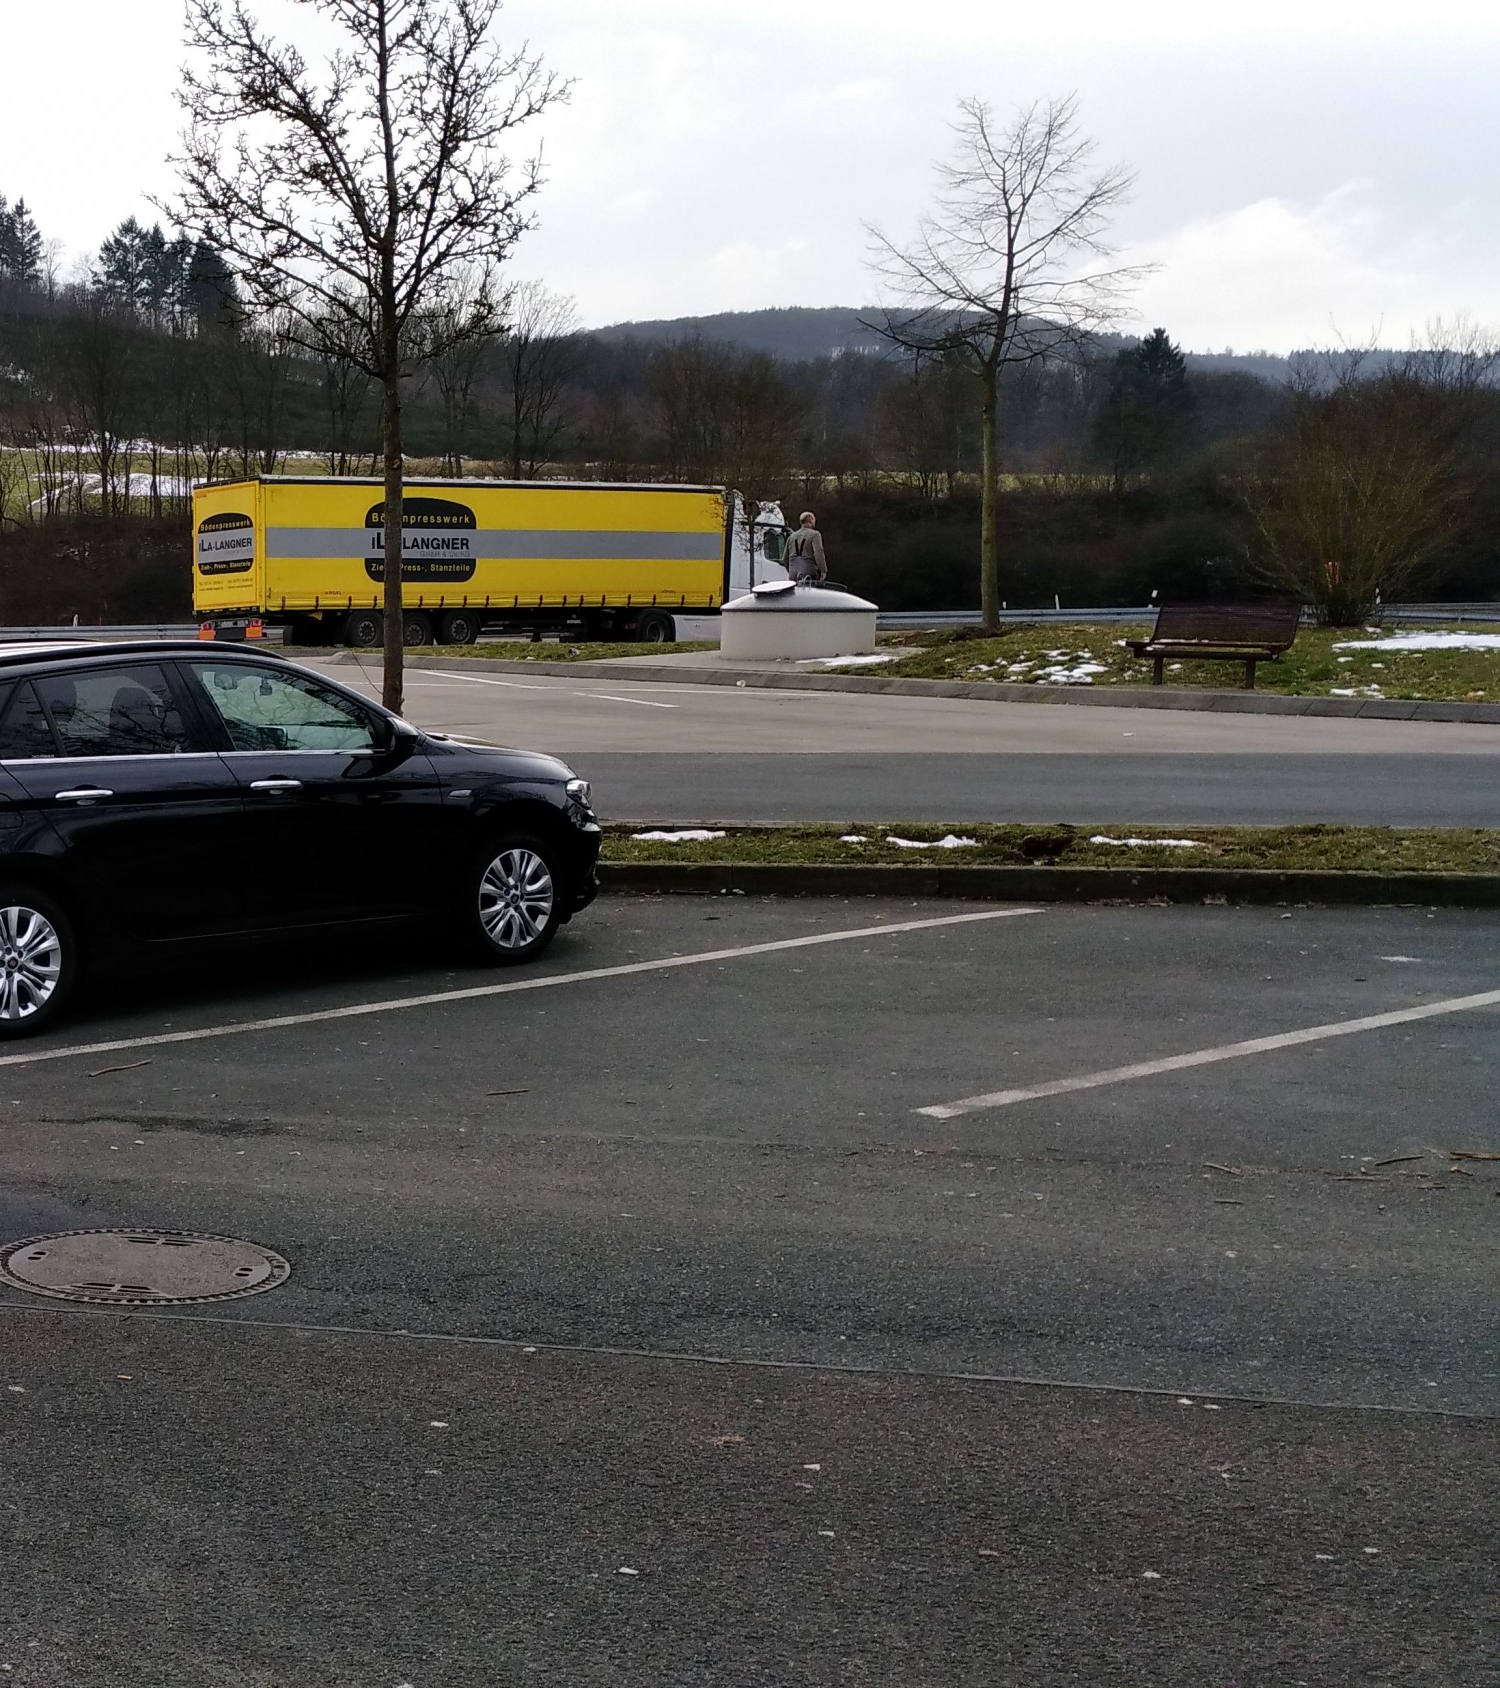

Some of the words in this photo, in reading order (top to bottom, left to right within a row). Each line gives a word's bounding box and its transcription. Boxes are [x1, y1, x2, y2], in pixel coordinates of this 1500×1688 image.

[371, 512, 470, 524] Bönpresswerk
[200, 519, 251, 532] Bödenpresswerk
[430, 563, 470, 571] Stanzteile
